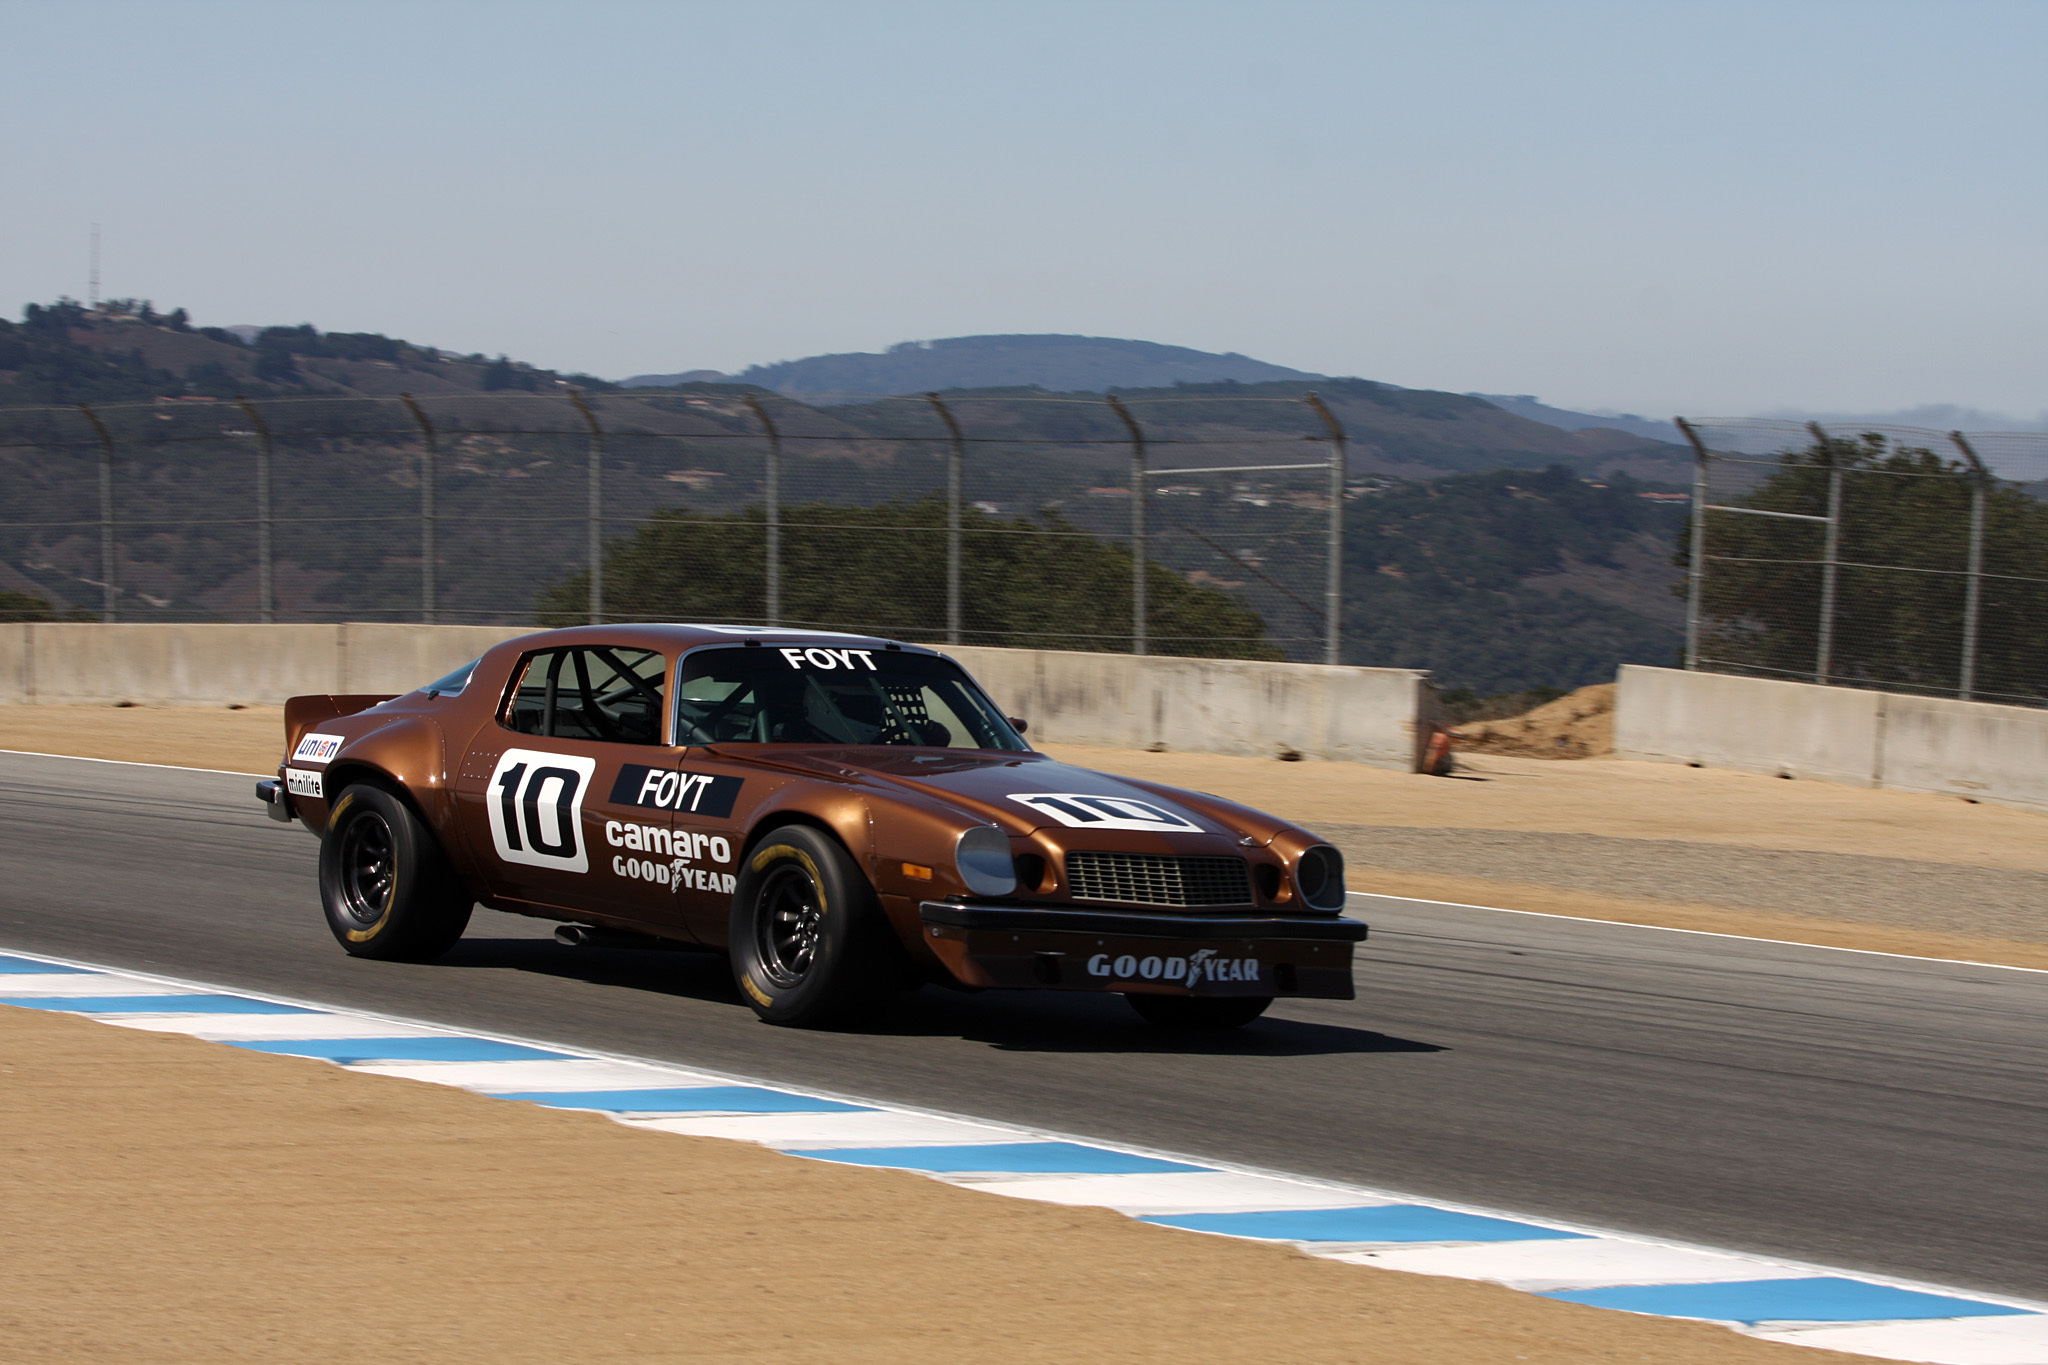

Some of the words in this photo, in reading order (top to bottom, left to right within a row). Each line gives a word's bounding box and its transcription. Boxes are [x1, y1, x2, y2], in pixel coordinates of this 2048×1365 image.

[779, 648, 878, 671] FOYT
[288, 773, 321, 795] minilite
[637, 768, 715, 812] FOYT
[498, 762, 581, 859] 10
[1024, 796, 1190, 827] 10
[605, 820, 731, 864] camaro
